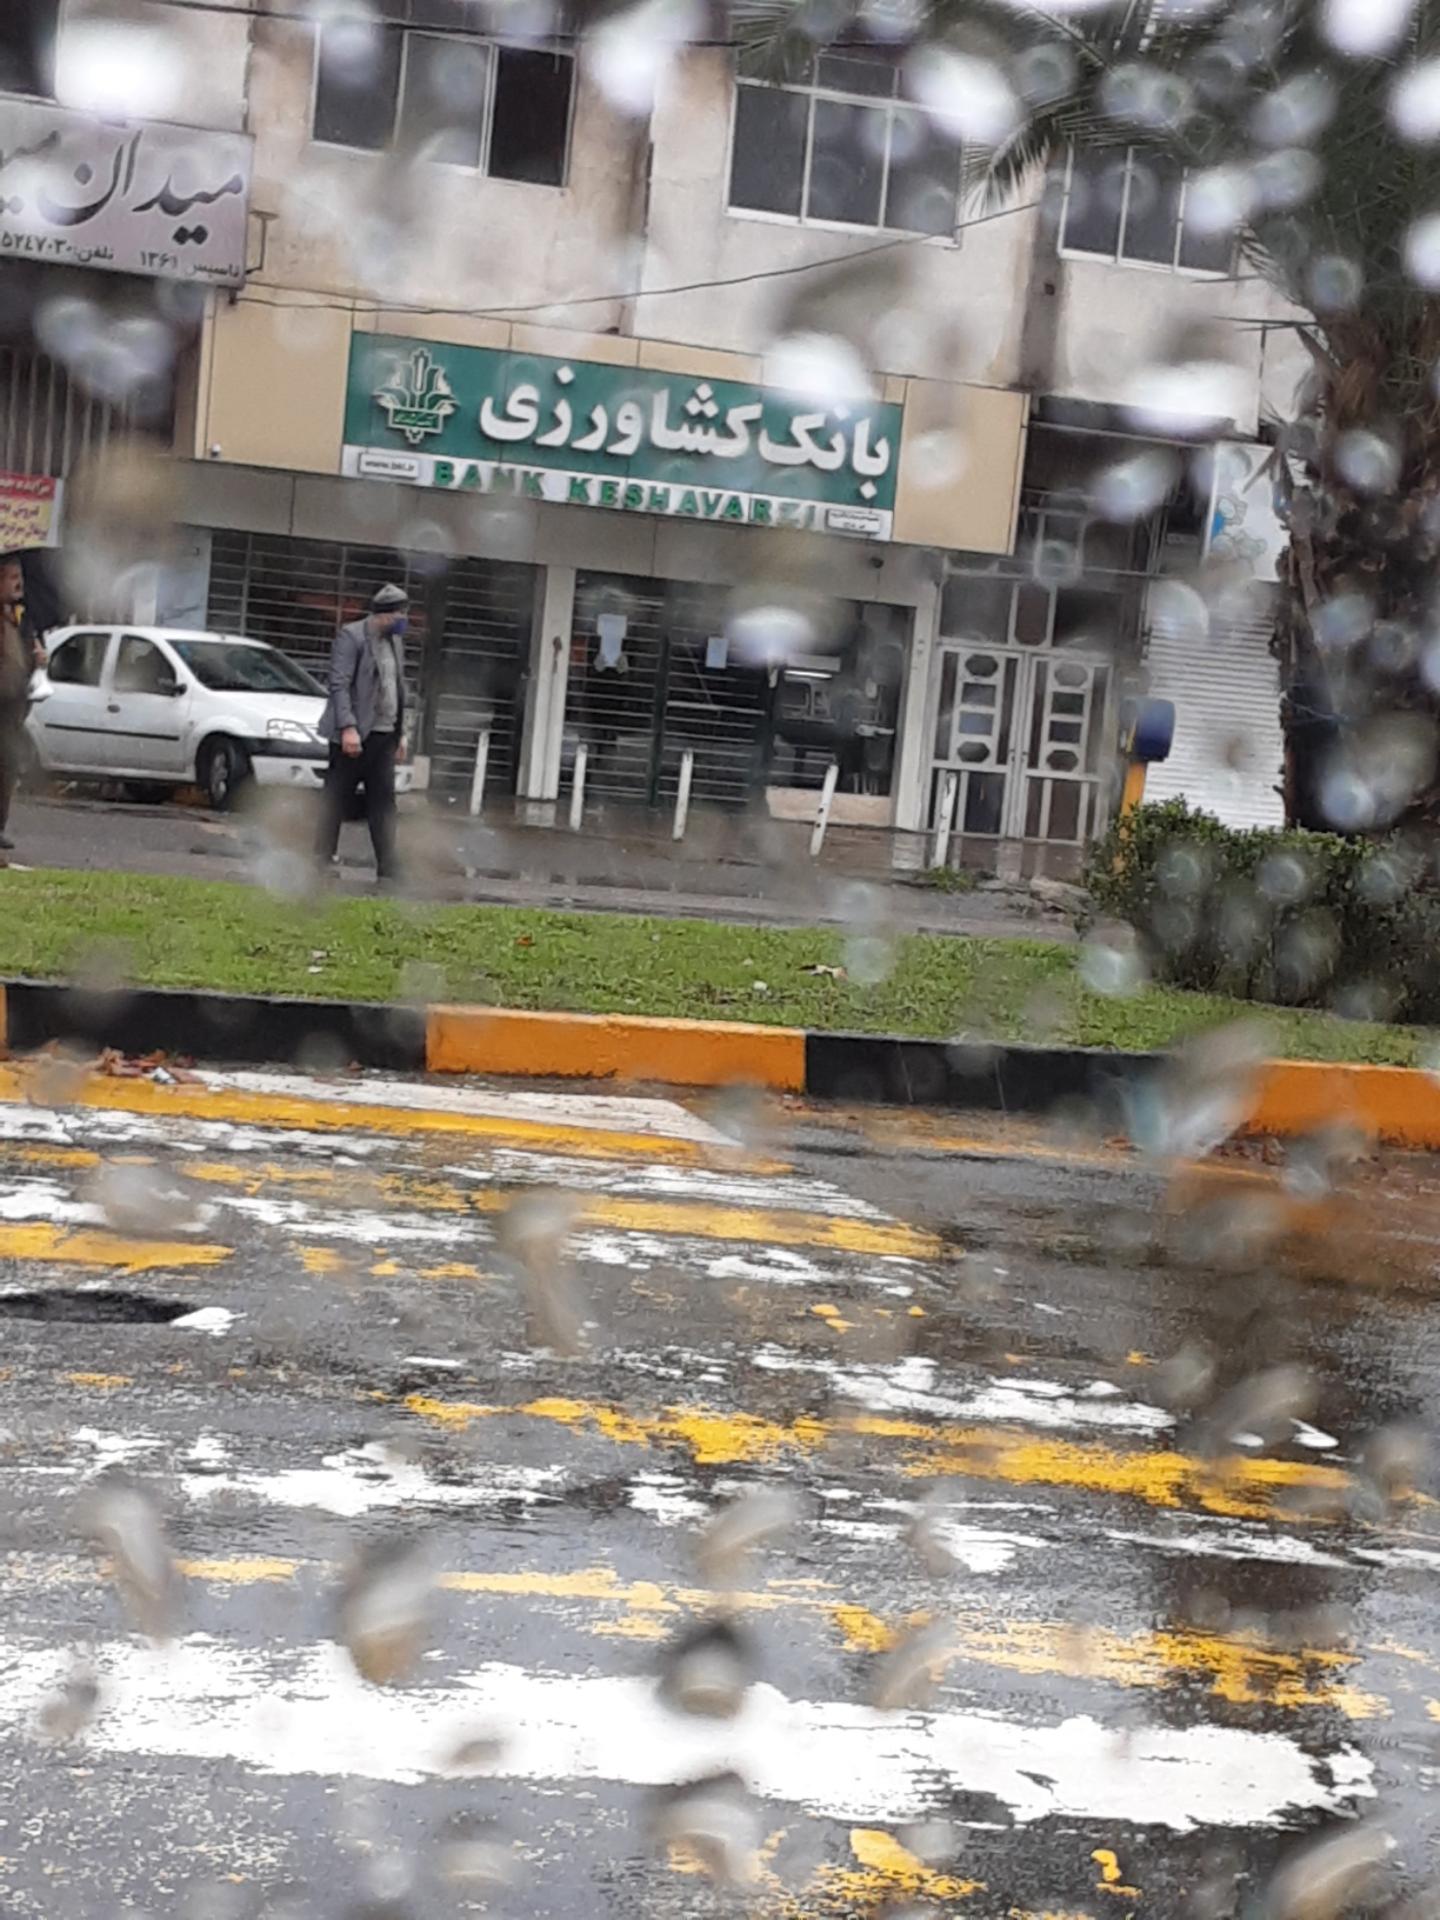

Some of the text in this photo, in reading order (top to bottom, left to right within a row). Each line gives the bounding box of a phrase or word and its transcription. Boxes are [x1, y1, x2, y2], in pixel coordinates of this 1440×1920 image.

[37, 129, 242, 245] میدان
[479, 365, 891, 500] بانک کشاورزی
